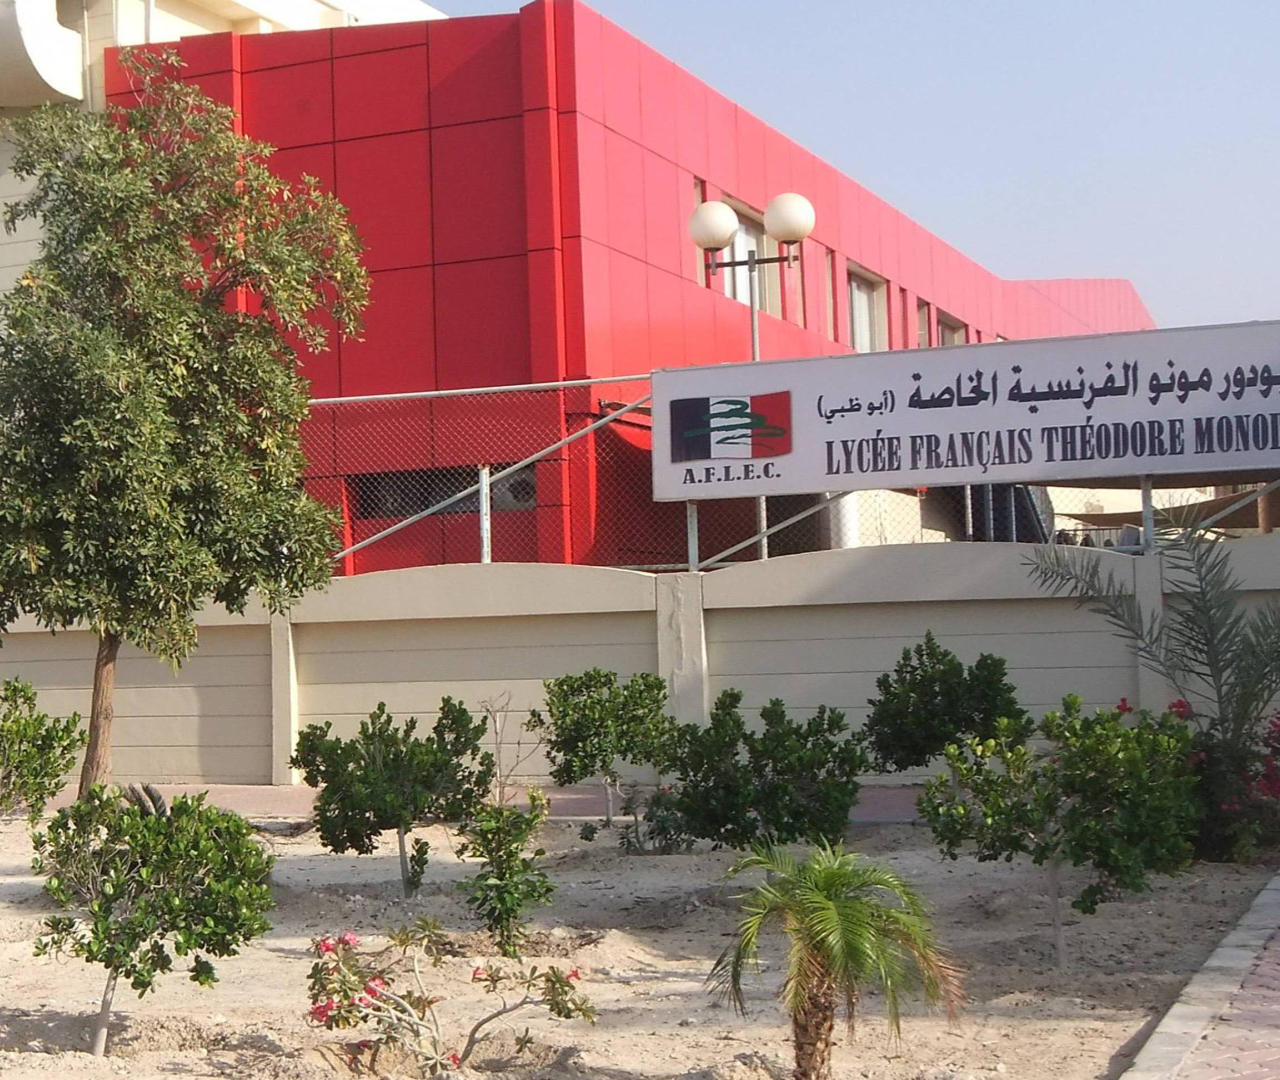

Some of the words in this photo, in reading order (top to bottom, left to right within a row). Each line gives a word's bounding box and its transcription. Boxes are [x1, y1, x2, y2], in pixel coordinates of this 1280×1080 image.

[907, 368, 998, 410] الخاصة
[1007, 360, 1139, 415] الفرنسية
[1148, 359, 1213, 406] مونو
[1217, 363, 1280, 402] ودور
[817, 394, 862, 425] ظبي)
[867, 389, 896, 417] (أبو
[825, 428, 901, 476] LYCÉE
[909, 428, 1033, 474] FRANÇAIS
[1040, 415, 1186, 462] THÉODORE
[682, 462, 781, 485] A.F.L.E.C.
